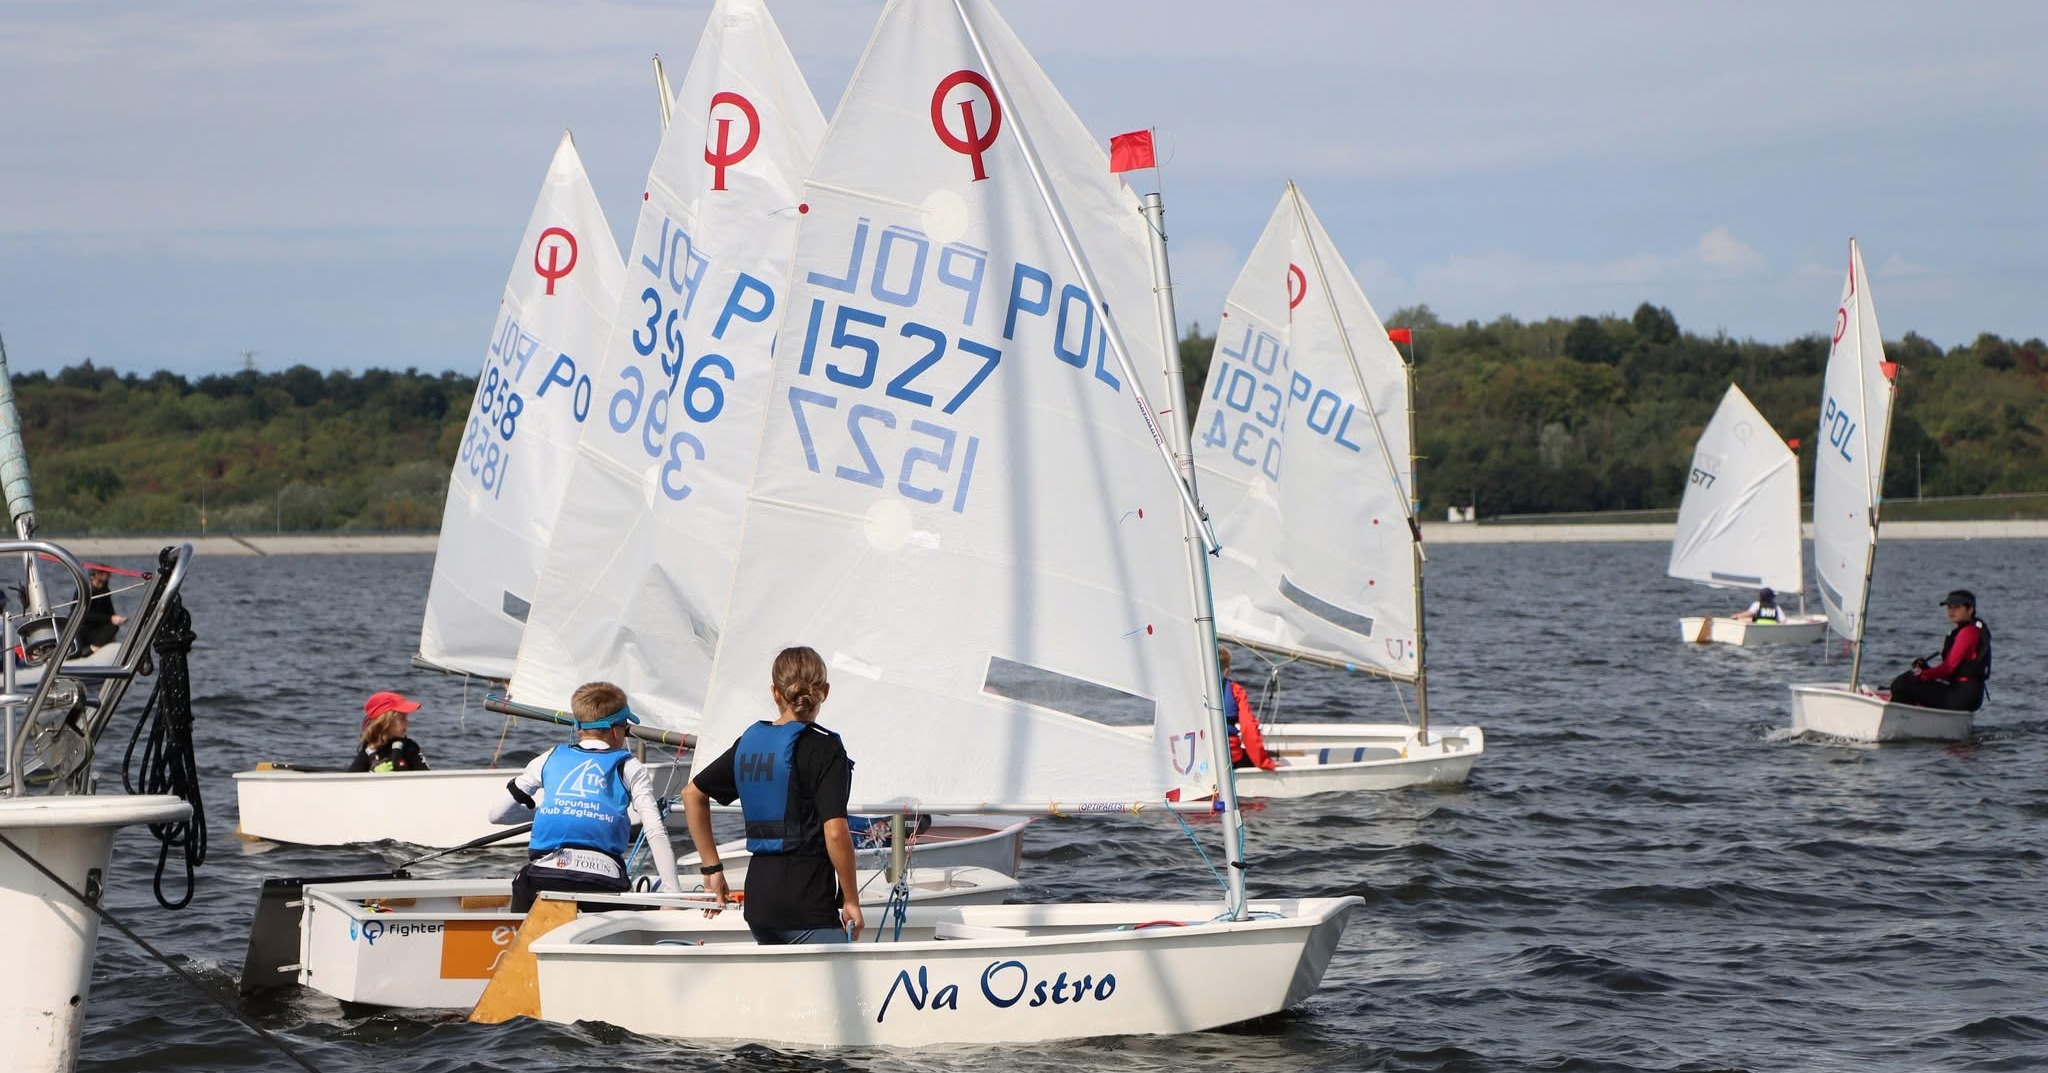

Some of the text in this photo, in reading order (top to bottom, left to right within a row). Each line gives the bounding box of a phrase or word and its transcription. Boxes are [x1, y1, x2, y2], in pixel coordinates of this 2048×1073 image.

[711, 272, 778, 360] P
[1003, 262, 1121, 393] POL
[536, 353, 591, 423] PO
[632, 287, 735, 424] 396
[798, 298, 1003, 415] 1527
[478, 358, 524, 441] 1858
[1211, 362, 1285, 434] 103
[1288, 370, 1361, 452] POL
[1823, 396, 1856, 463] POL
[1691, 468, 1717, 490] 577
[740, 752, 776, 782] HH
[539, 806, 560, 815] Klub
[389, 923, 444, 937] fighter
[877, 960, 1116, 1023] Na Ostro
